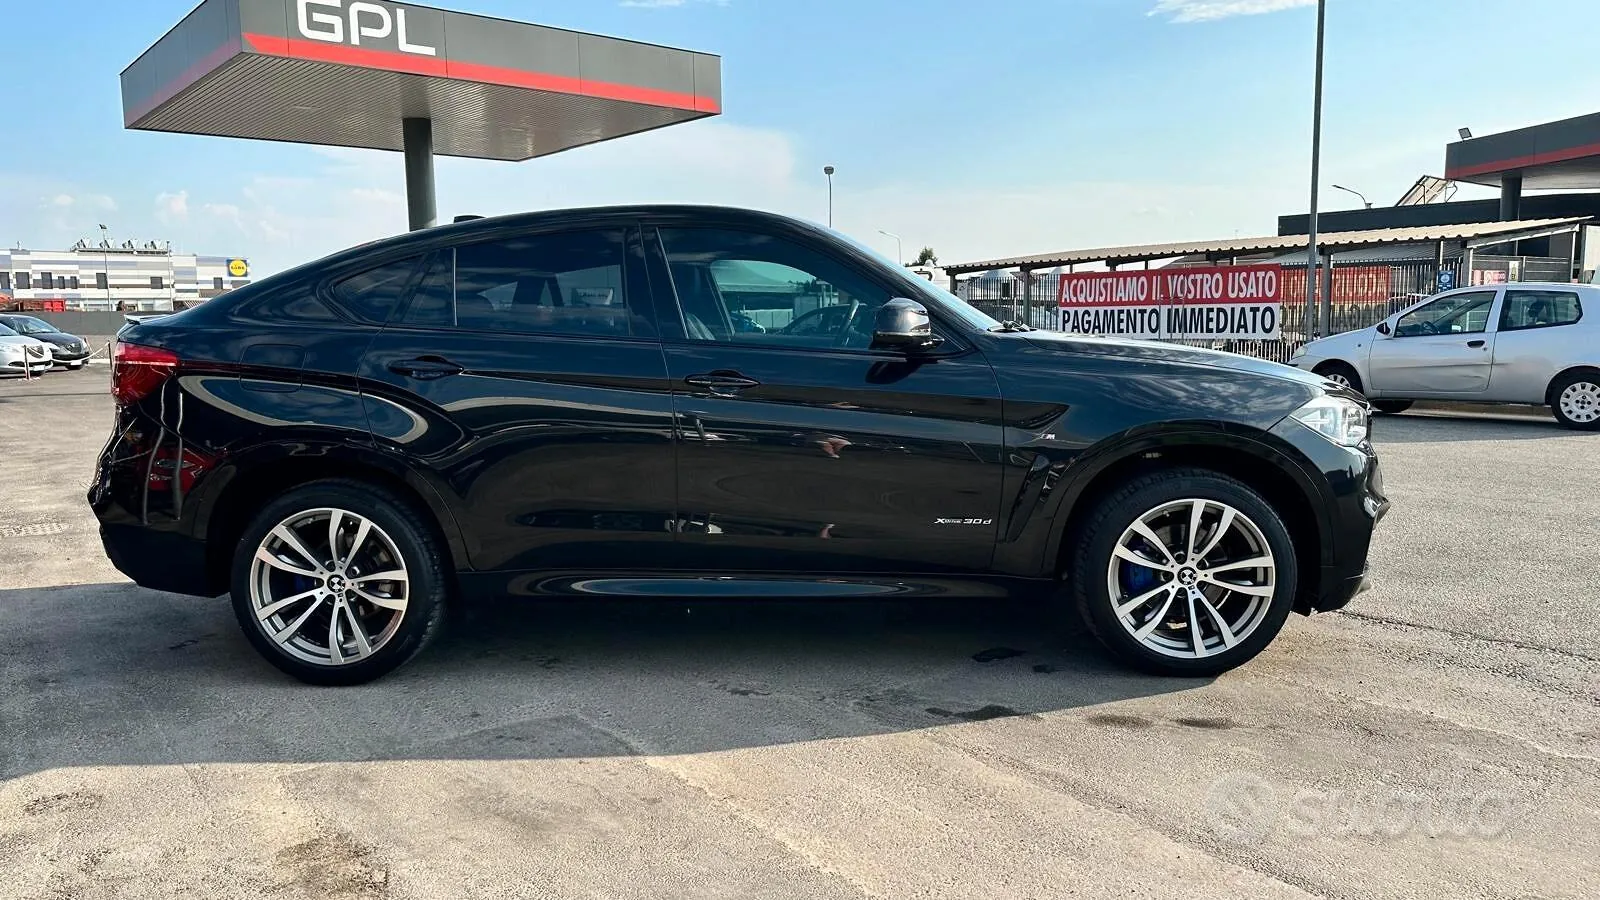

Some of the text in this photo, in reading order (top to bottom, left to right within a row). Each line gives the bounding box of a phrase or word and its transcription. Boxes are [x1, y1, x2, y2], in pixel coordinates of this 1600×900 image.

[297, 0, 436, 56] GPL
[1061, 276, 1148, 303] ACQUISTIAMO
[1168, 274, 1223, 300] VOSTRO
[1227, 270, 1276, 298] USATO
[1062, 306, 1276, 334] PAGAMENTO IMMEDIATO
